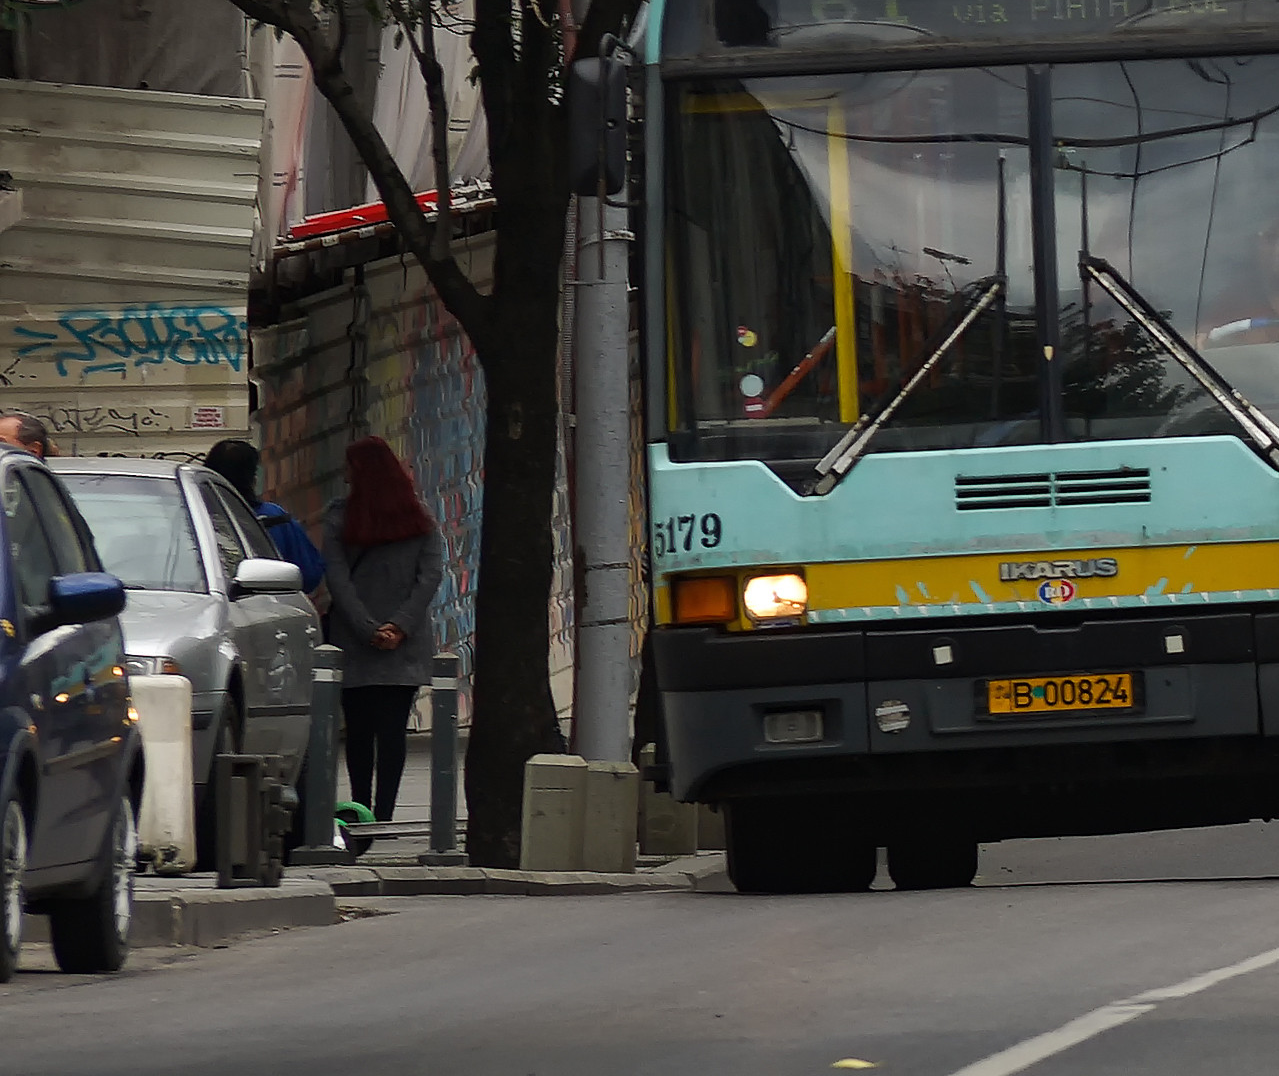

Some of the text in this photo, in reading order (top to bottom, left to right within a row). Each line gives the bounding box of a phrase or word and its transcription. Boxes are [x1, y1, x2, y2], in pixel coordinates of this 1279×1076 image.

[653, 511, 722, 559] 5179
[999, 557, 1119, 582] IKARUS
[1013, 676, 1128, 709] B 00824
